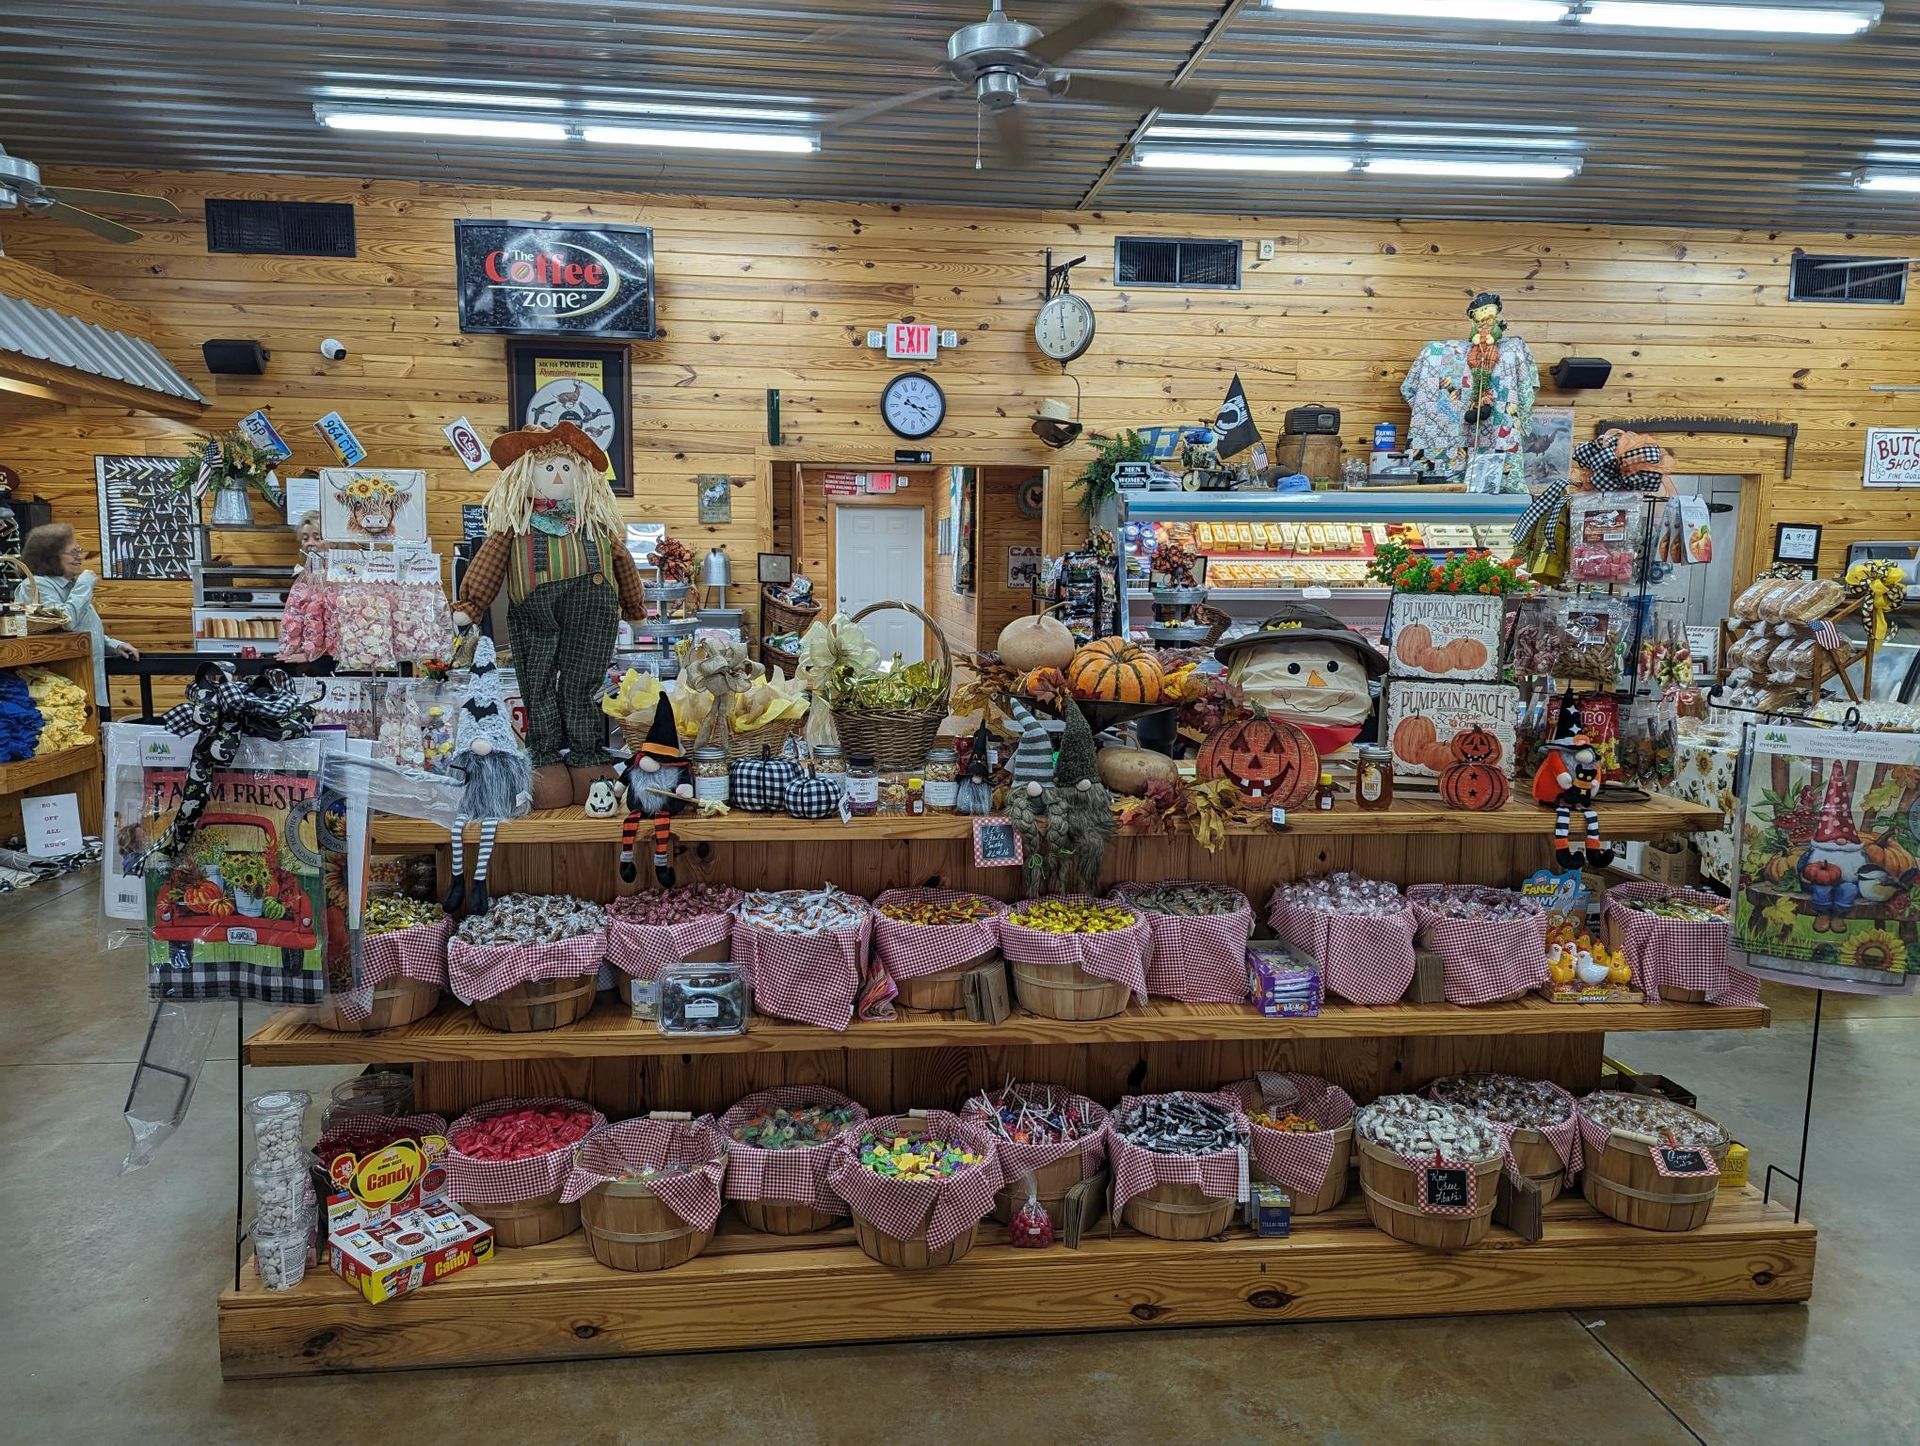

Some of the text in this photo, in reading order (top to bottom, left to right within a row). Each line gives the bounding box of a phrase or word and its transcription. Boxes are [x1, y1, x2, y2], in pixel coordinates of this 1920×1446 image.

[512, 250, 535, 262] The
[485, 249, 603, 286] Coffee
[523, 291, 581, 309] zone
[895, 325, 930, 354] EXIT
[559, 360, 598, 369] POWERFUL
[245, 418, 267, 436] 45P
[323, 419, 343, 441] 964
[338, 438, 358, 461] CTD
[1886, 458, 1919, 471] SHOP
[1785, 533, 1791, 541] A
[1402, 601, 1491, 628] PUMPKIN PATCH
[1446, 620, 1471, 628] Apple
[1450, 628, 1484, 636] Orchard
[1401, 690, 1507, 722] PUMPKIN PATCH
[1452, 712, 1482, 721] Apple
[1816, 734, 1889, 746] Decorative Garden Flag
[152, 781, 309, 822] FAM FRESH
[1523, 883, 1559, 895] FANCY
[1582, 988, 1609, 996] FANCY
[377, 1163, 391, 1171] KING
[366, 1163, 414, 1192] Candy
[440, 1233, 464, 1245] CANDY
[410, 1244, 433, 1257] CANDY
[434, 1250, 470, 1277] Candy
